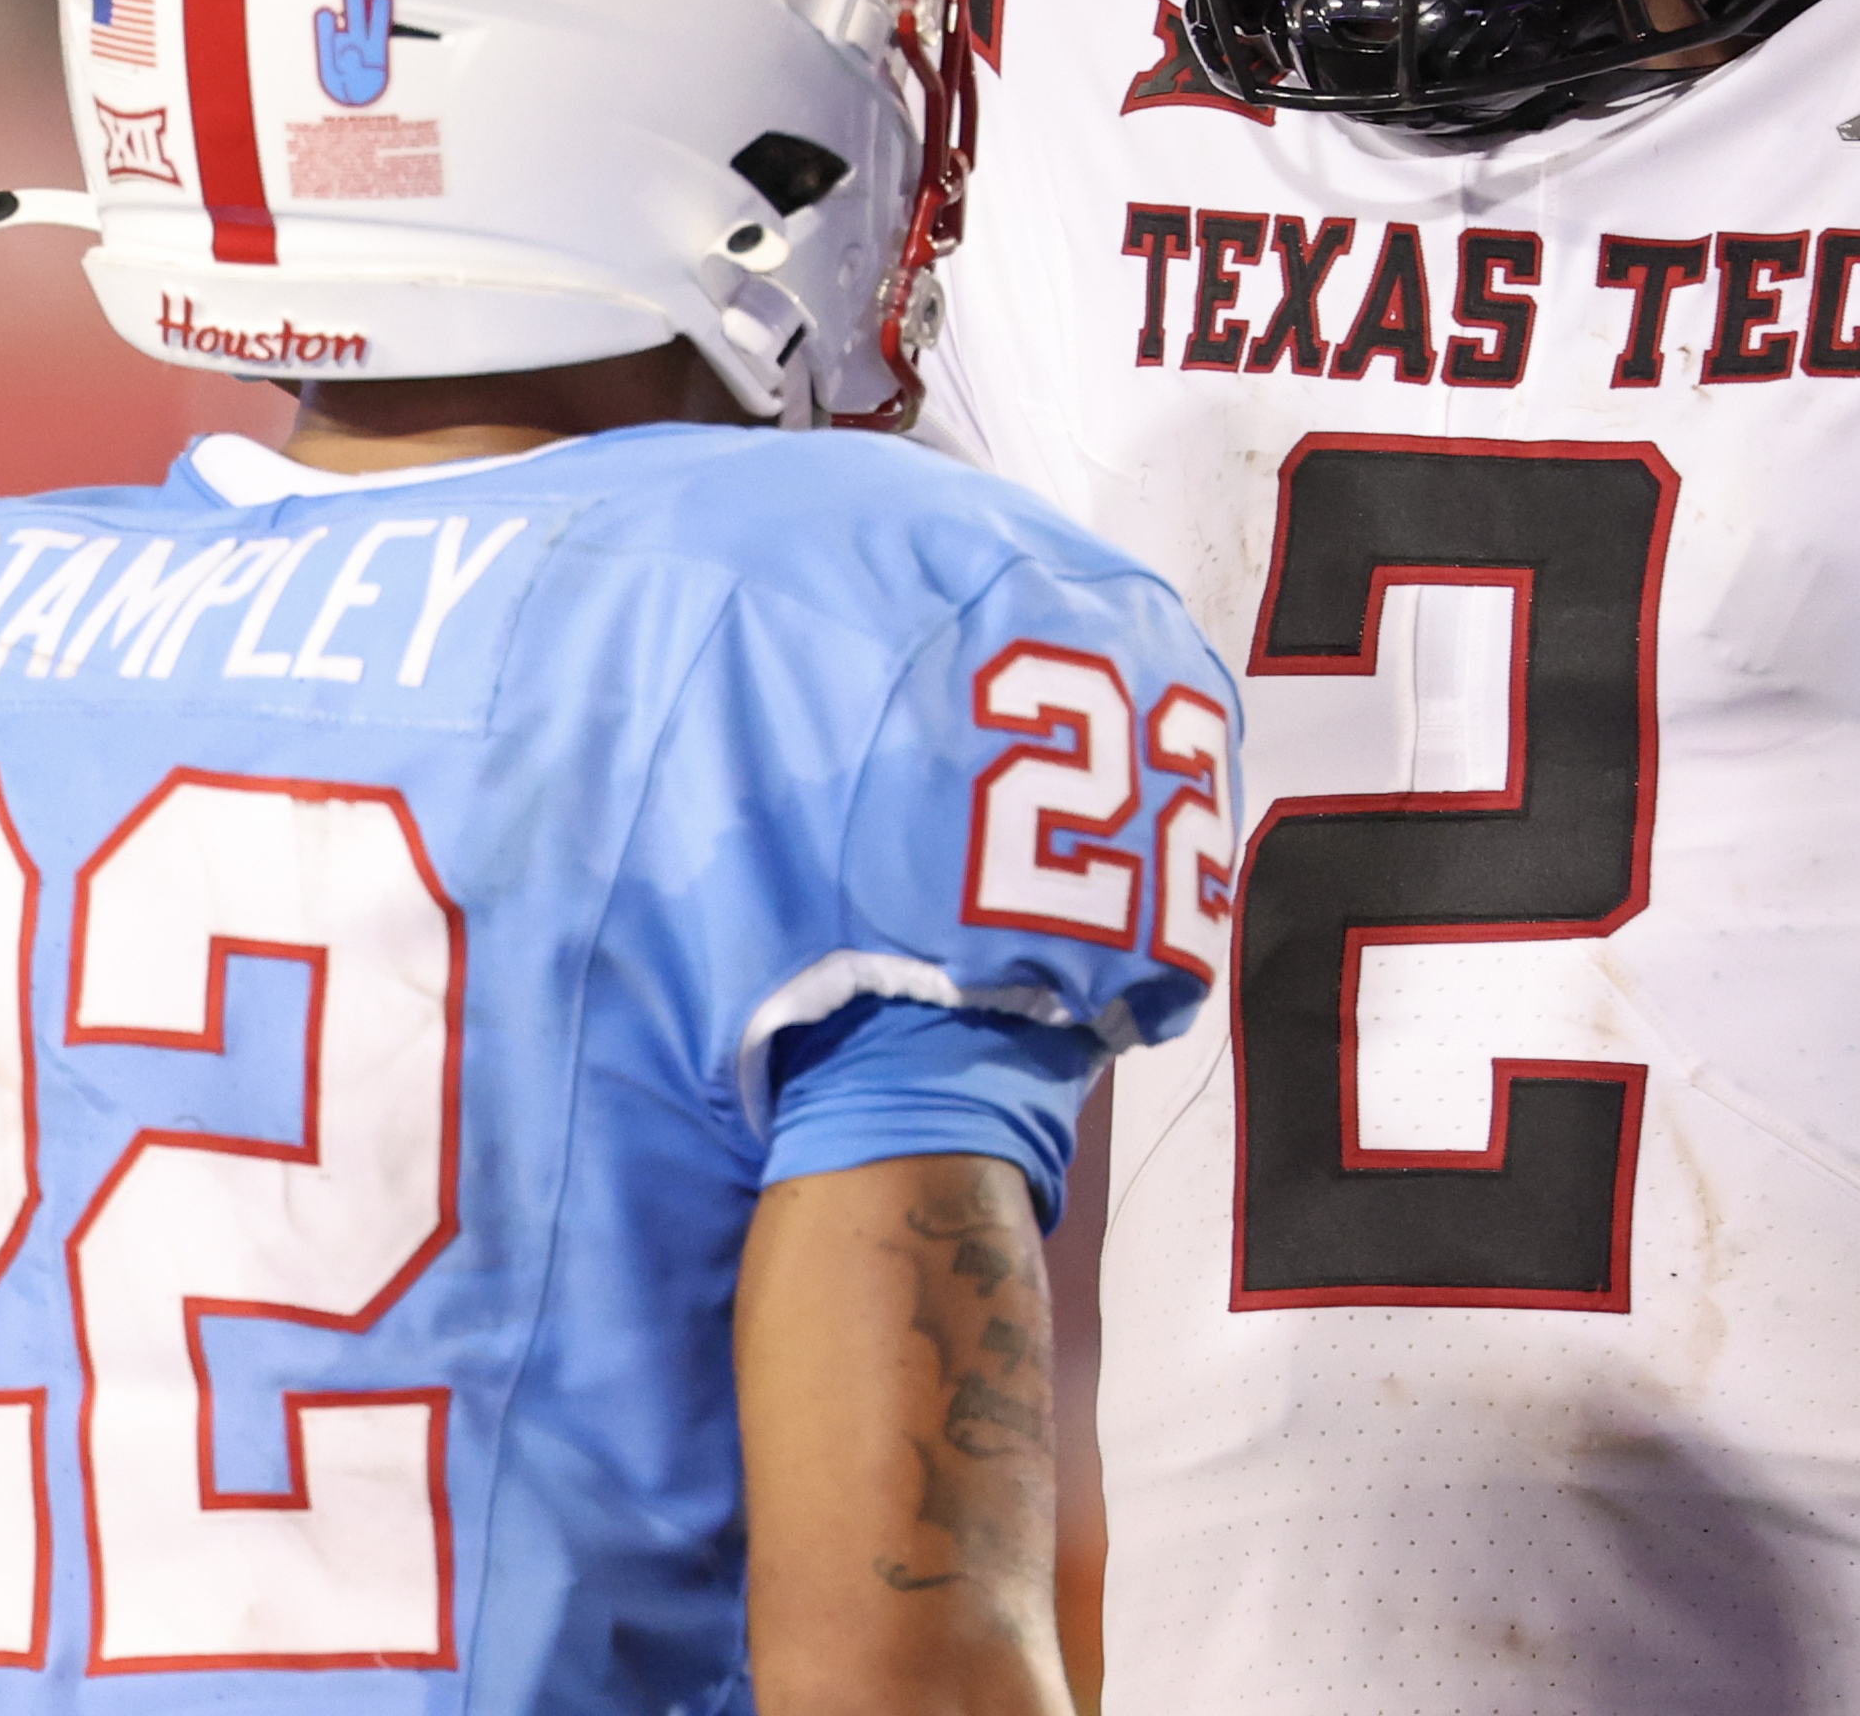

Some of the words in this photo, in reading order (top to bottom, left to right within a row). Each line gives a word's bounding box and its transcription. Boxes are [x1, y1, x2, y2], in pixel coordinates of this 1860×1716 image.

[155, 290, 369, 366] Houston
[1122, 200, 1543, 388] TEXAS
[960, 639, 1244, 985] 22
[1228, 431, 1681, 1314] 2
